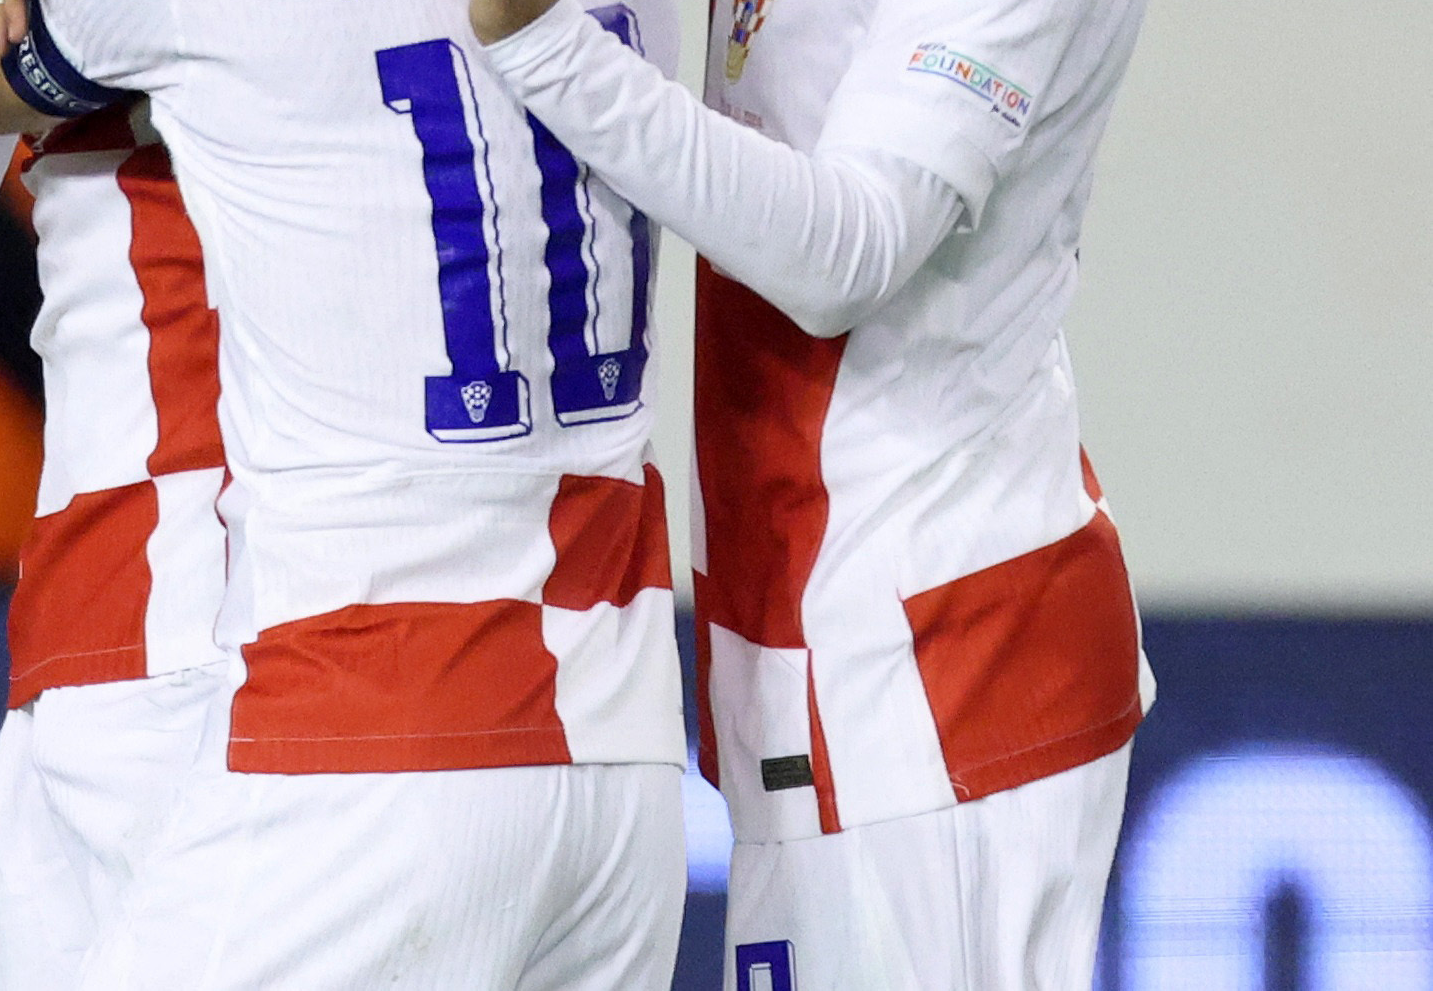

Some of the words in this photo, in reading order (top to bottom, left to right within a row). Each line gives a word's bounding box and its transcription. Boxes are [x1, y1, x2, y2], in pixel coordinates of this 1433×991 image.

[18, 35, 77, 108] RESP
[909, 52, 1030, 115] FOUNDATION
[375, 4, 653, 443] 10
